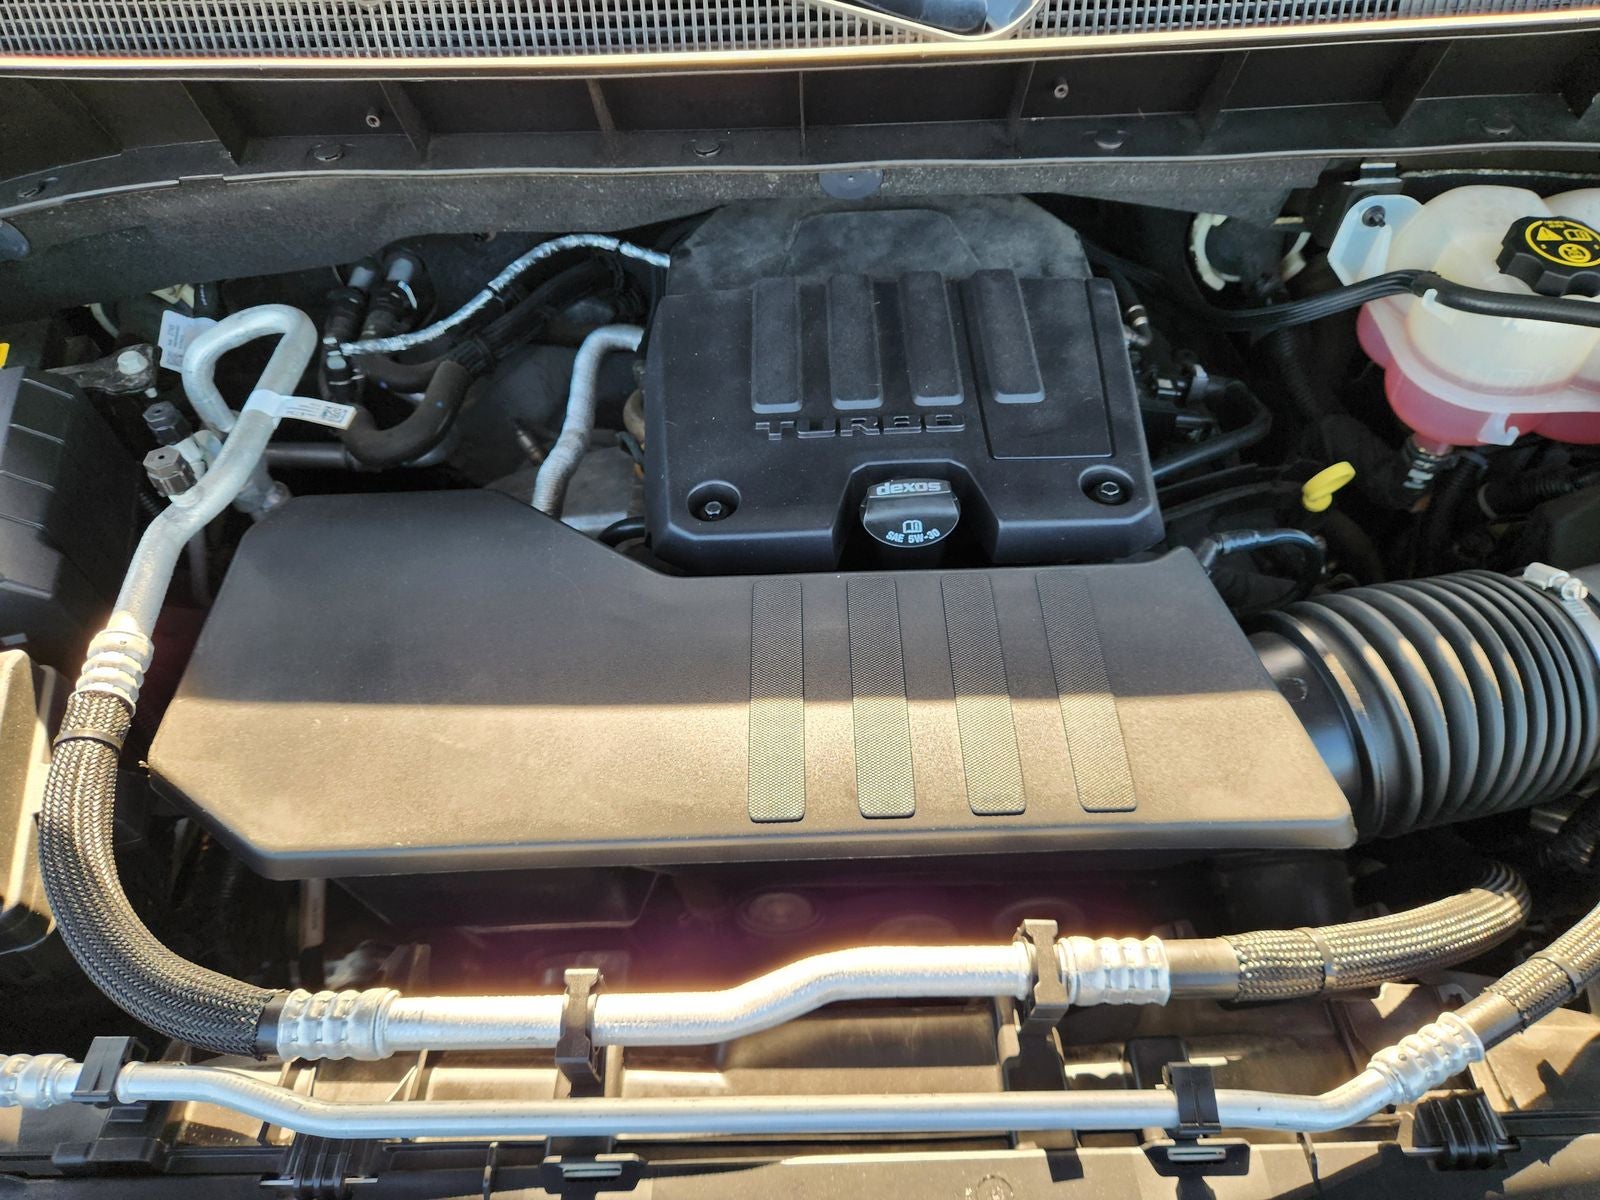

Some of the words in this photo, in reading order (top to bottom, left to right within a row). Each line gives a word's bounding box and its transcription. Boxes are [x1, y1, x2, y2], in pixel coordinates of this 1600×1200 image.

[755, 414, 965, 440] TURBO
[876, 482, 941, 496] dexos
[885, 530, 905, 543] SAE
[907, 528, 940, 544] 5W-30
